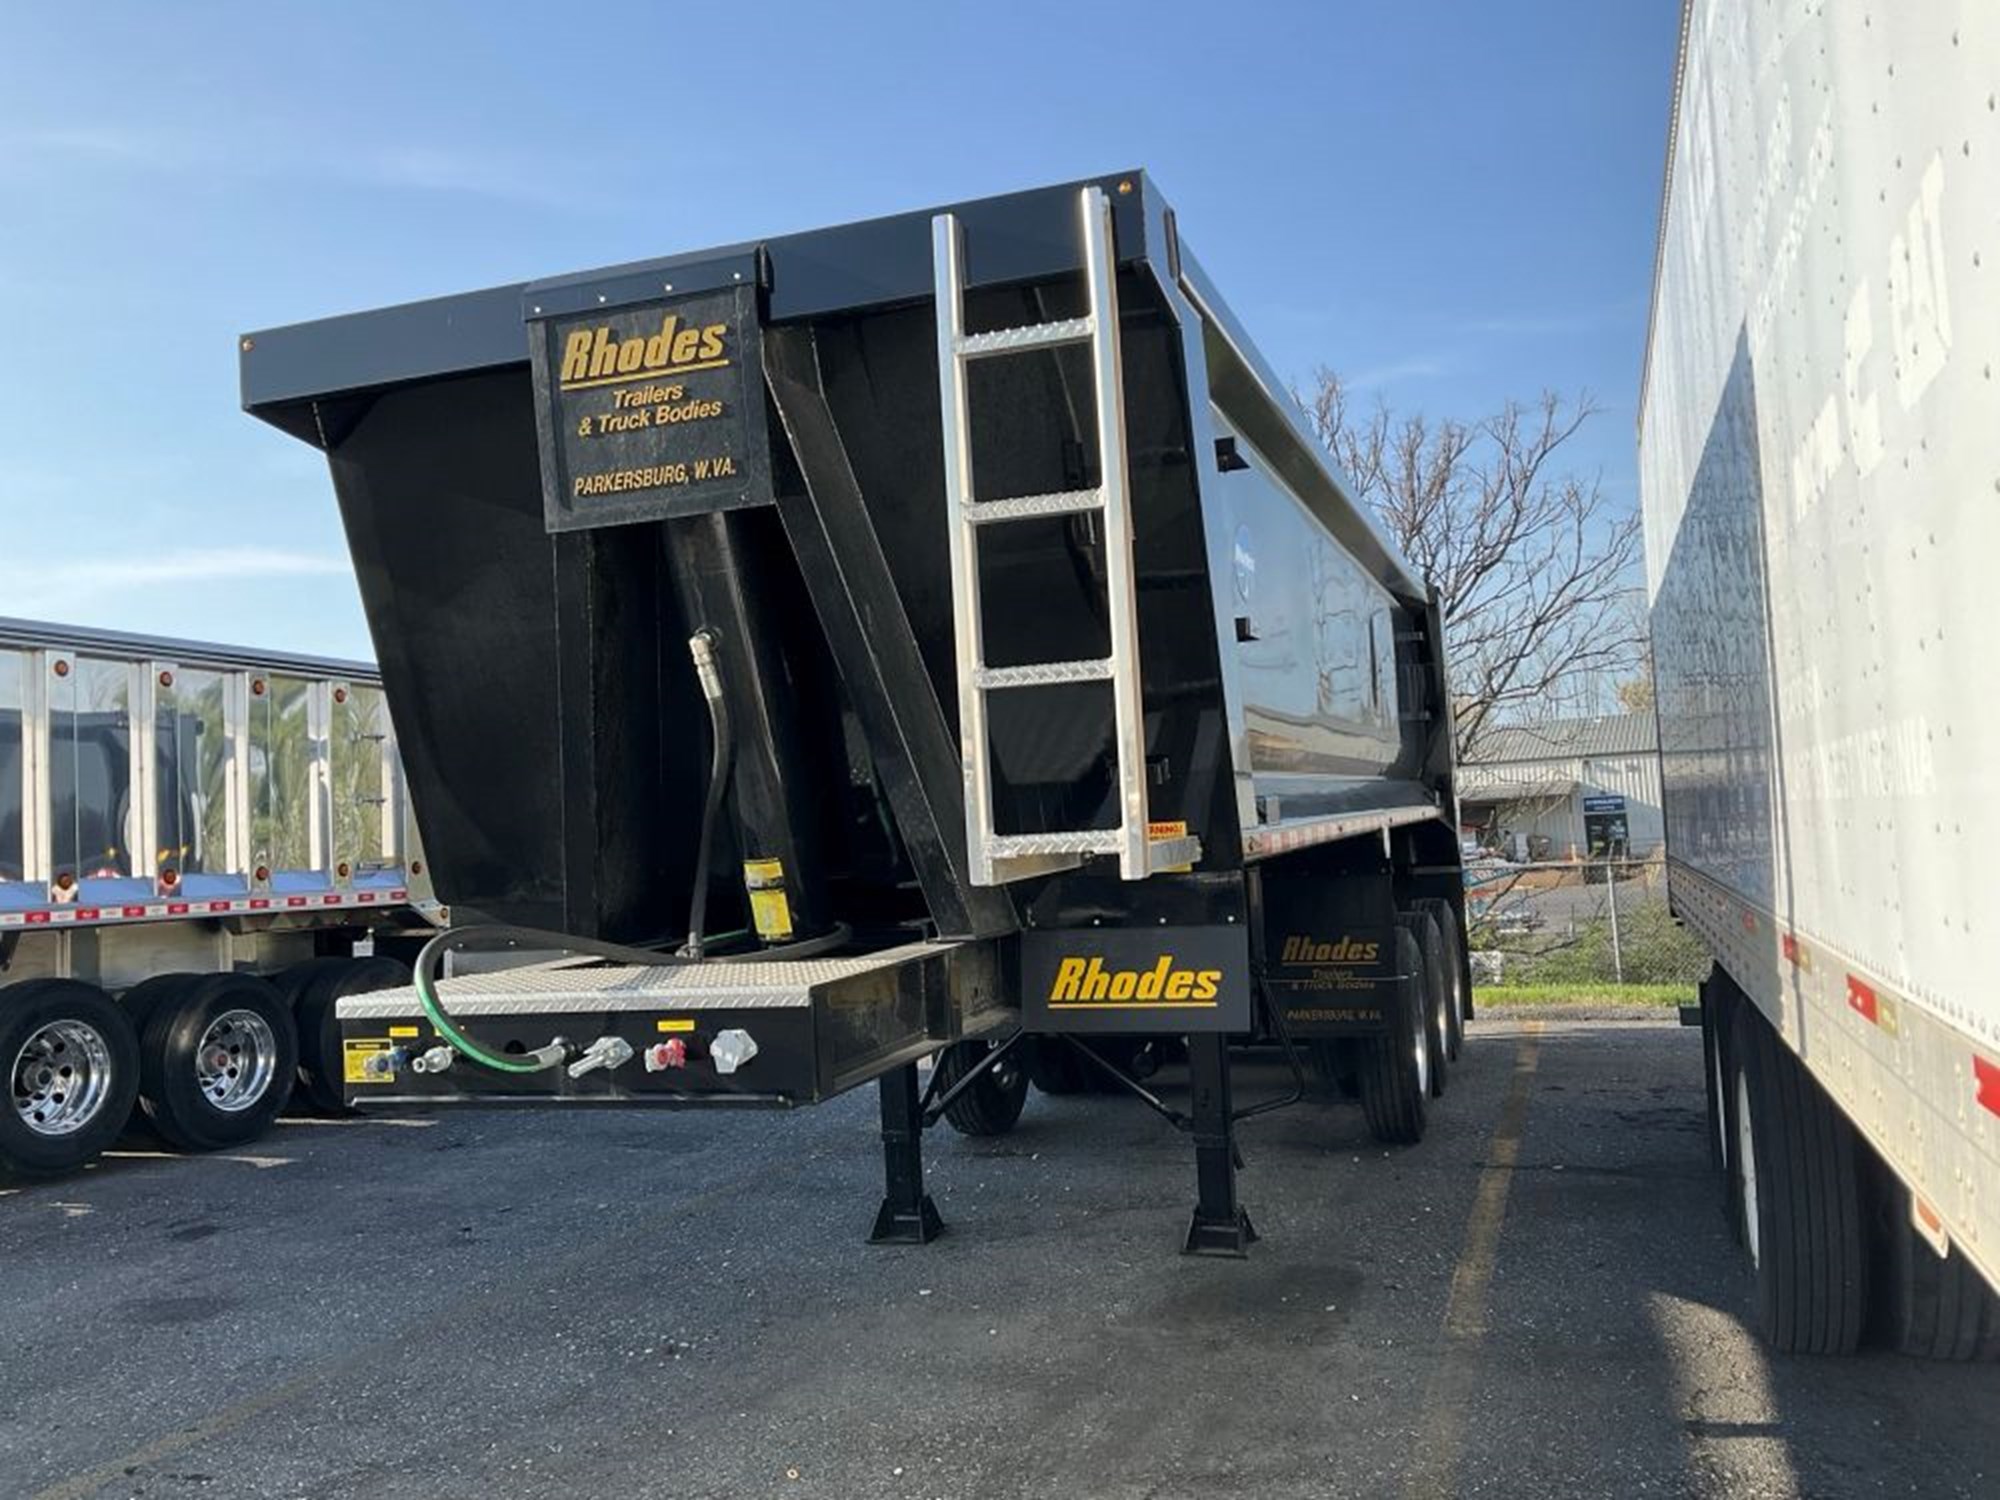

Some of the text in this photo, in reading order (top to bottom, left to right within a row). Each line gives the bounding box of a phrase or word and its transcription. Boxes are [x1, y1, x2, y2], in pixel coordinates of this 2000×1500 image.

[560, 315, 727, 382] Rhodes
[613, 384, 684, 409] Trailers
[578, 400, 722, 437] & Truck Bodies
[574, 456, 737, 497] PARKERSBURG, W.VA.
[1282, 935, 1379, 961] Rhodes
[1050, 955, 1222, 1001] Rhodes
